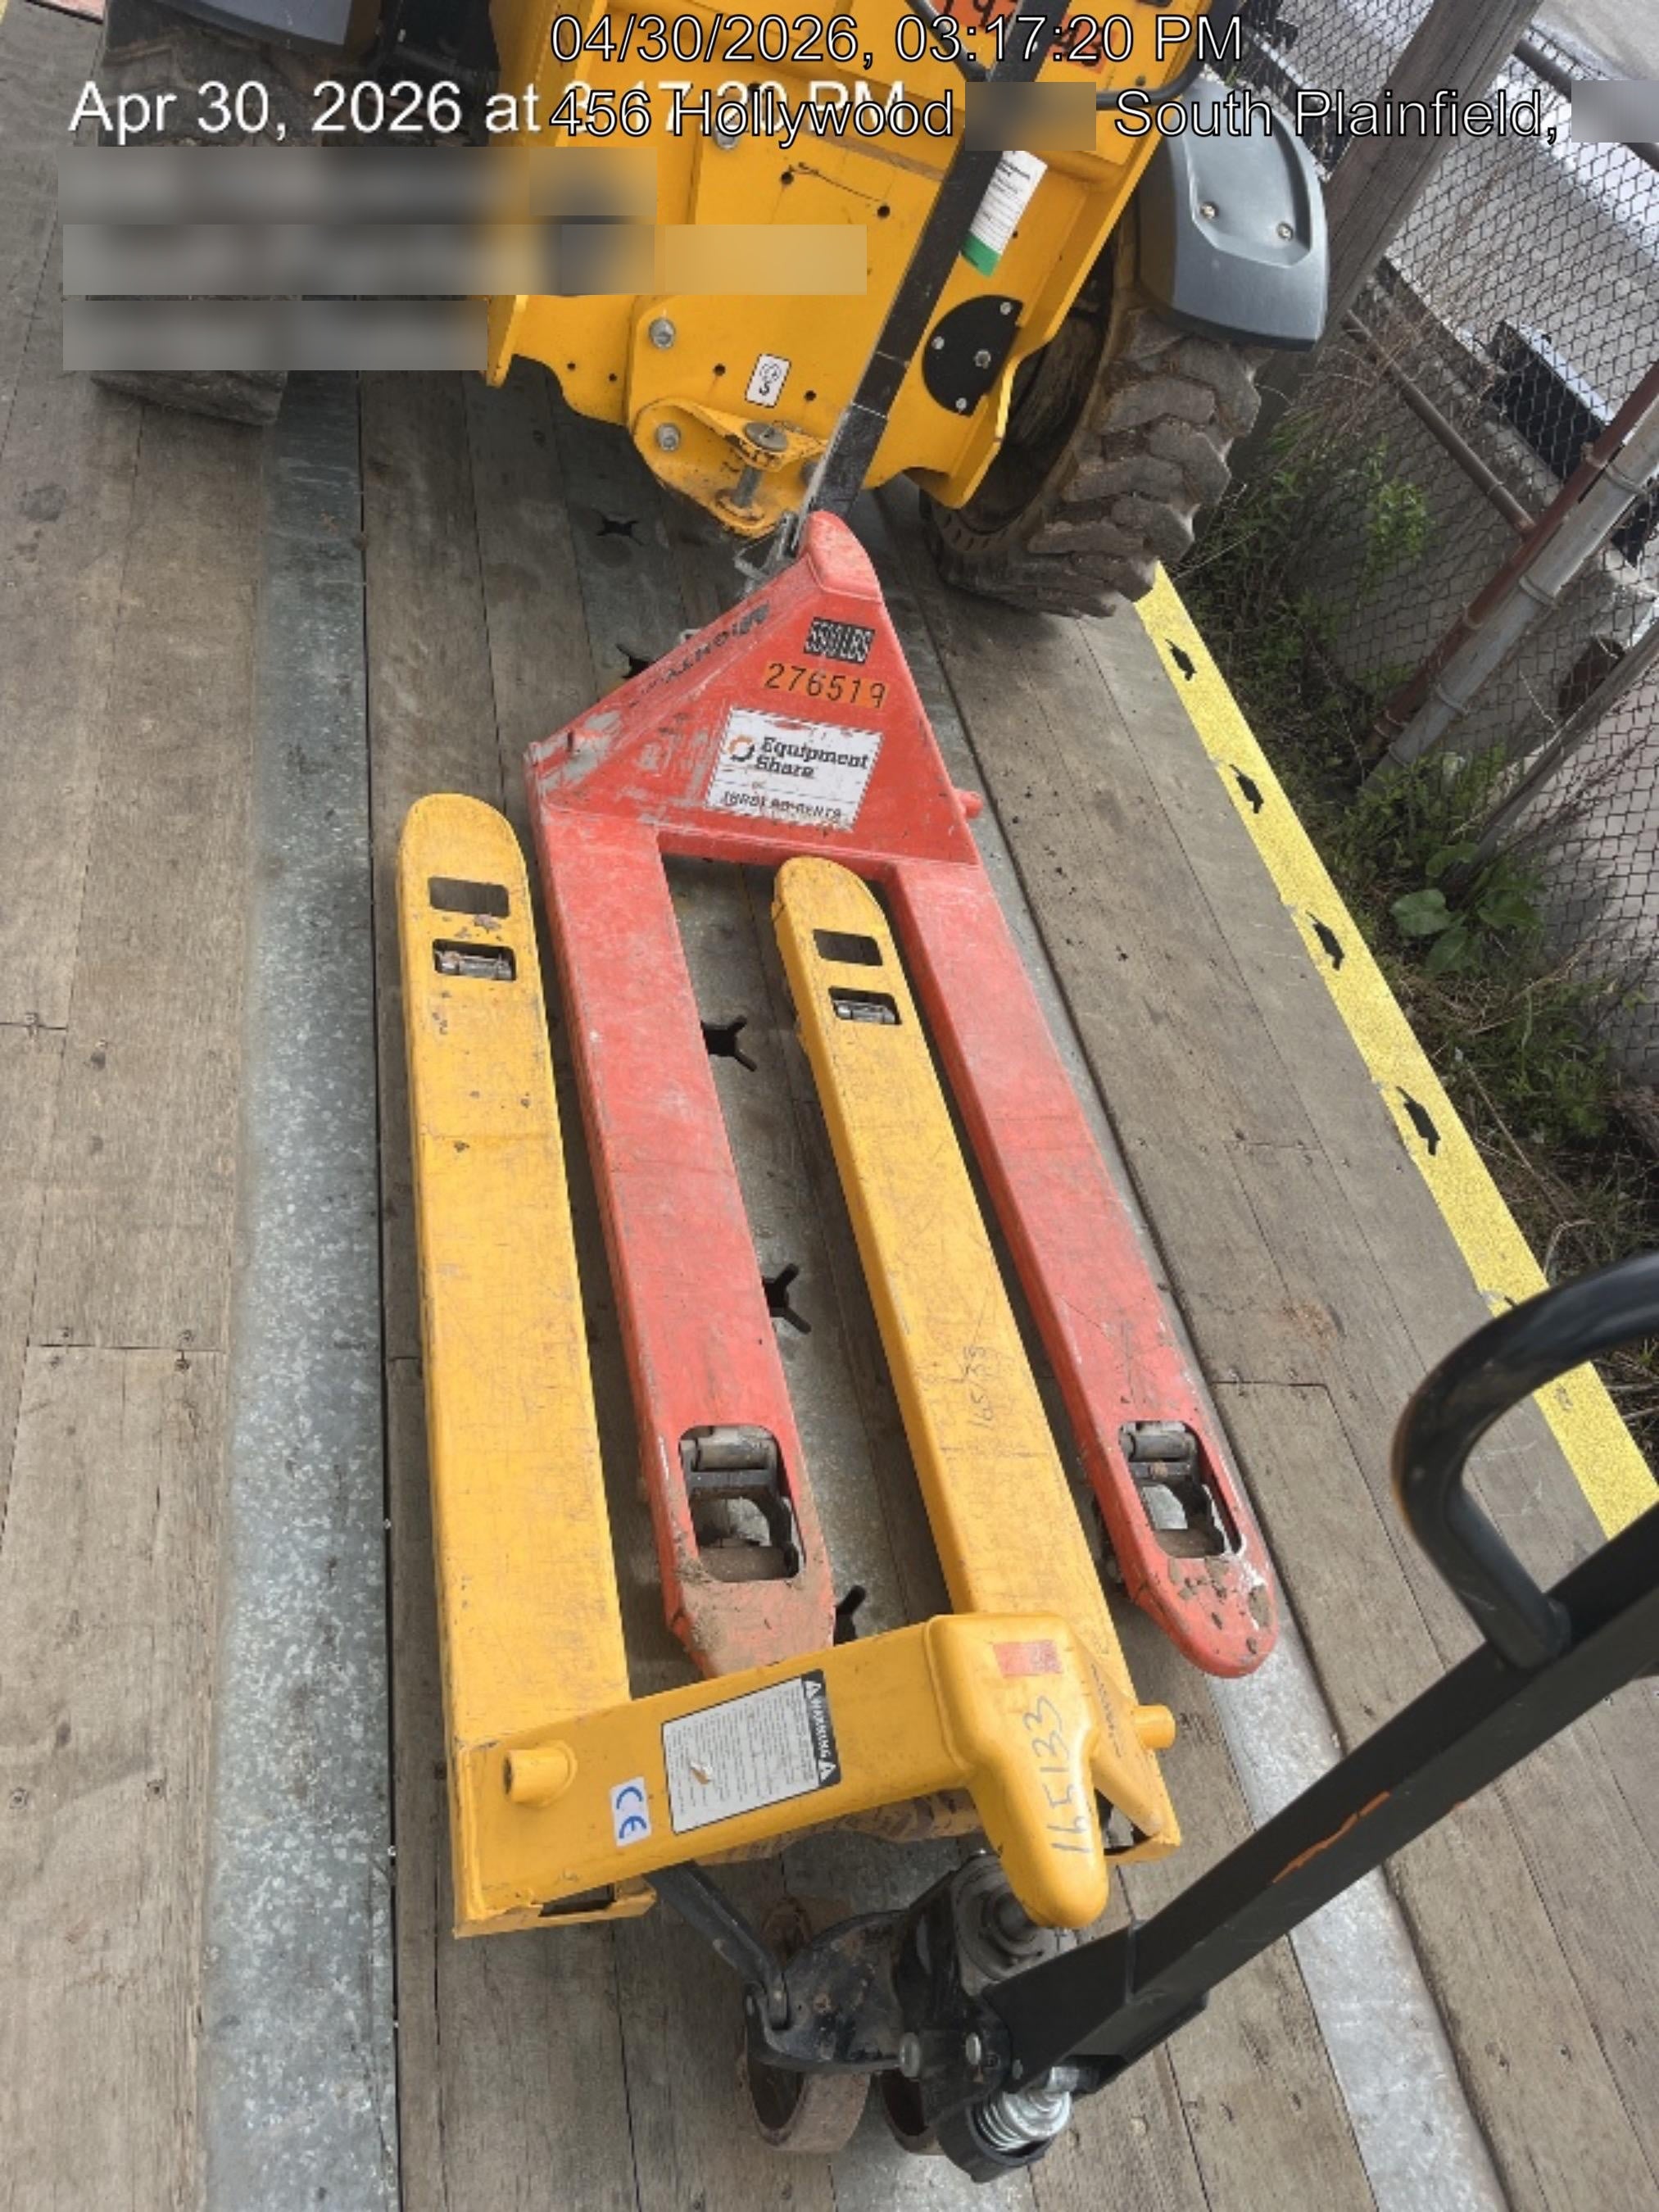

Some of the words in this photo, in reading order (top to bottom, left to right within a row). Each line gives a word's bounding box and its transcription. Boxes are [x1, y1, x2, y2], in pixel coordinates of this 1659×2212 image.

[765, 662, 886, 709] 276519
[755, 755, 815, 778] Share
[760, 736, 869, 769] Equipment
[1022, 1695, 1090, 1853] 165133
[616, 1786, 647, 1839] CE
